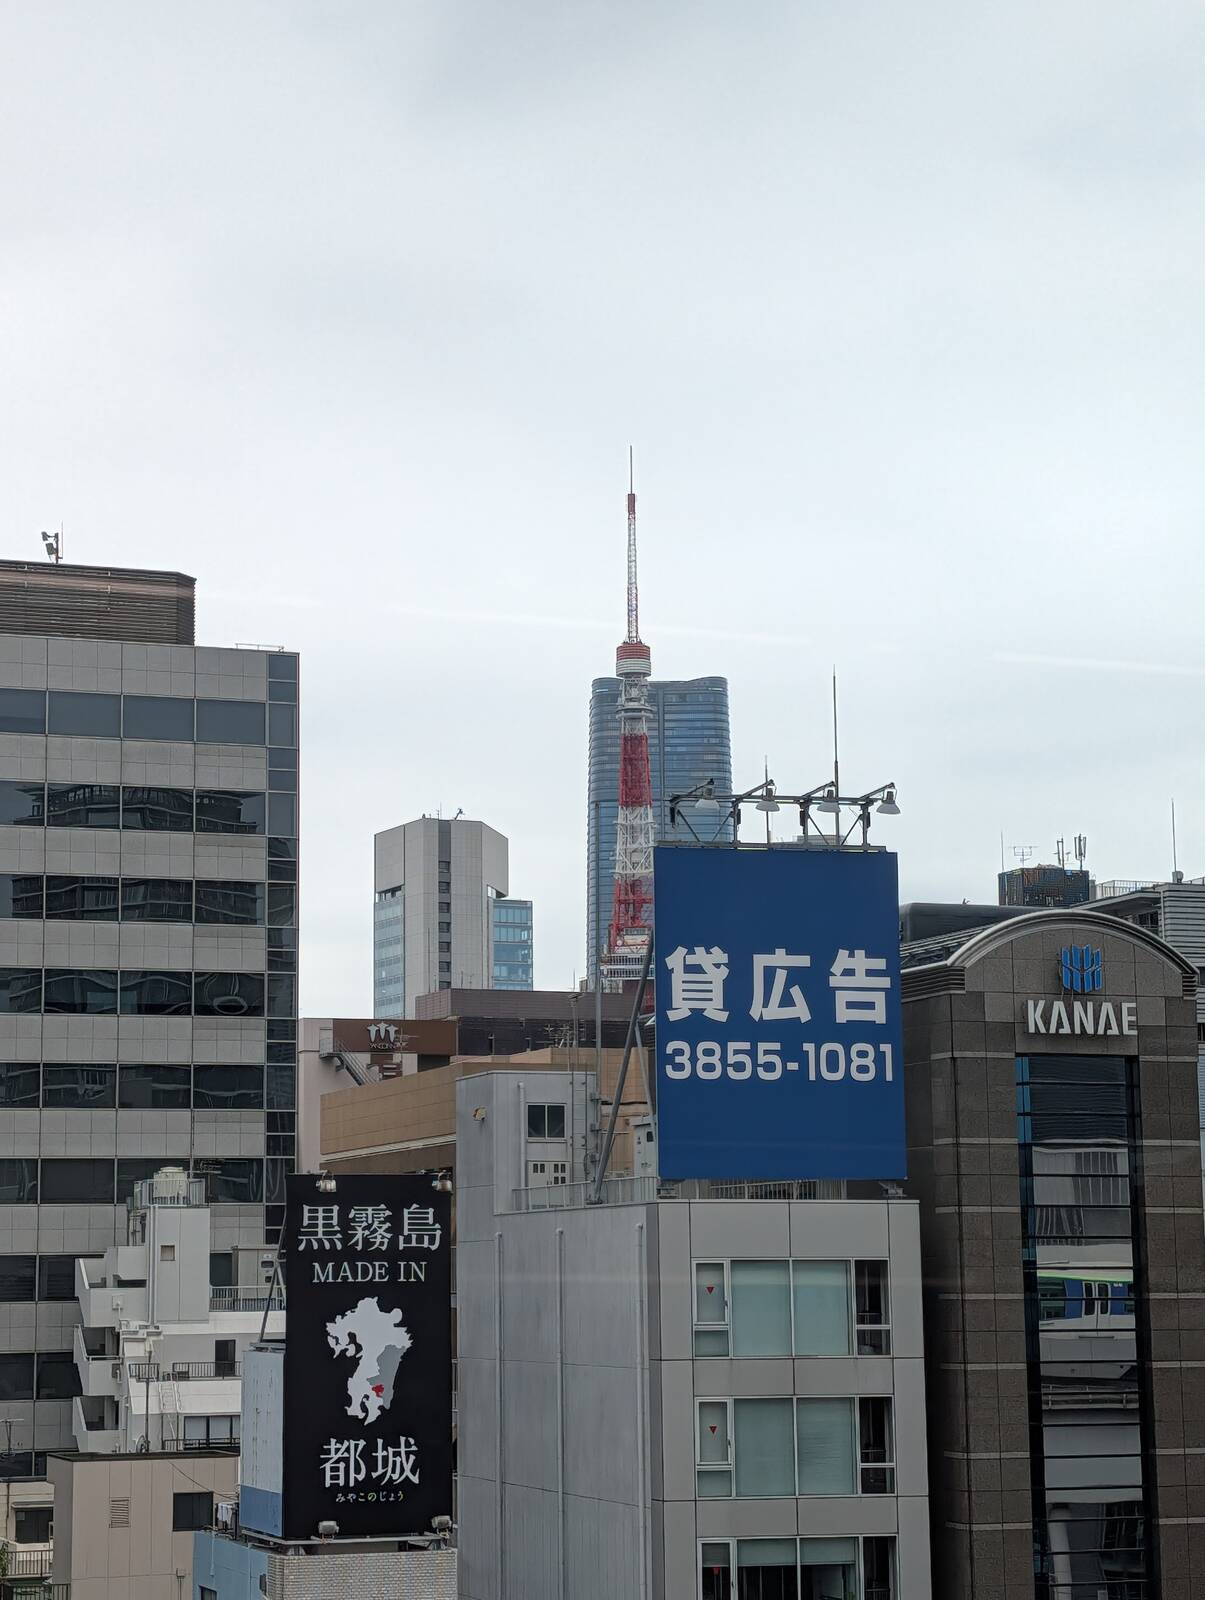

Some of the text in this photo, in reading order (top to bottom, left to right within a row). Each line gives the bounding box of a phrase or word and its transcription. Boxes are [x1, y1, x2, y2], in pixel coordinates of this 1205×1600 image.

[665, 946, 891, 1024] 貸広告
[1027, 999, 1138, 1036] KANAE
[665, 1041, 893, 1081] 3855-1081
[298, 1204, 443, 1251] 黒霧島
[312, 1262, 427, 1283] MADE IN
[320, 1436, 420, 1487] 都城
[336, 1490, 404, 1503] みやこのじょう
